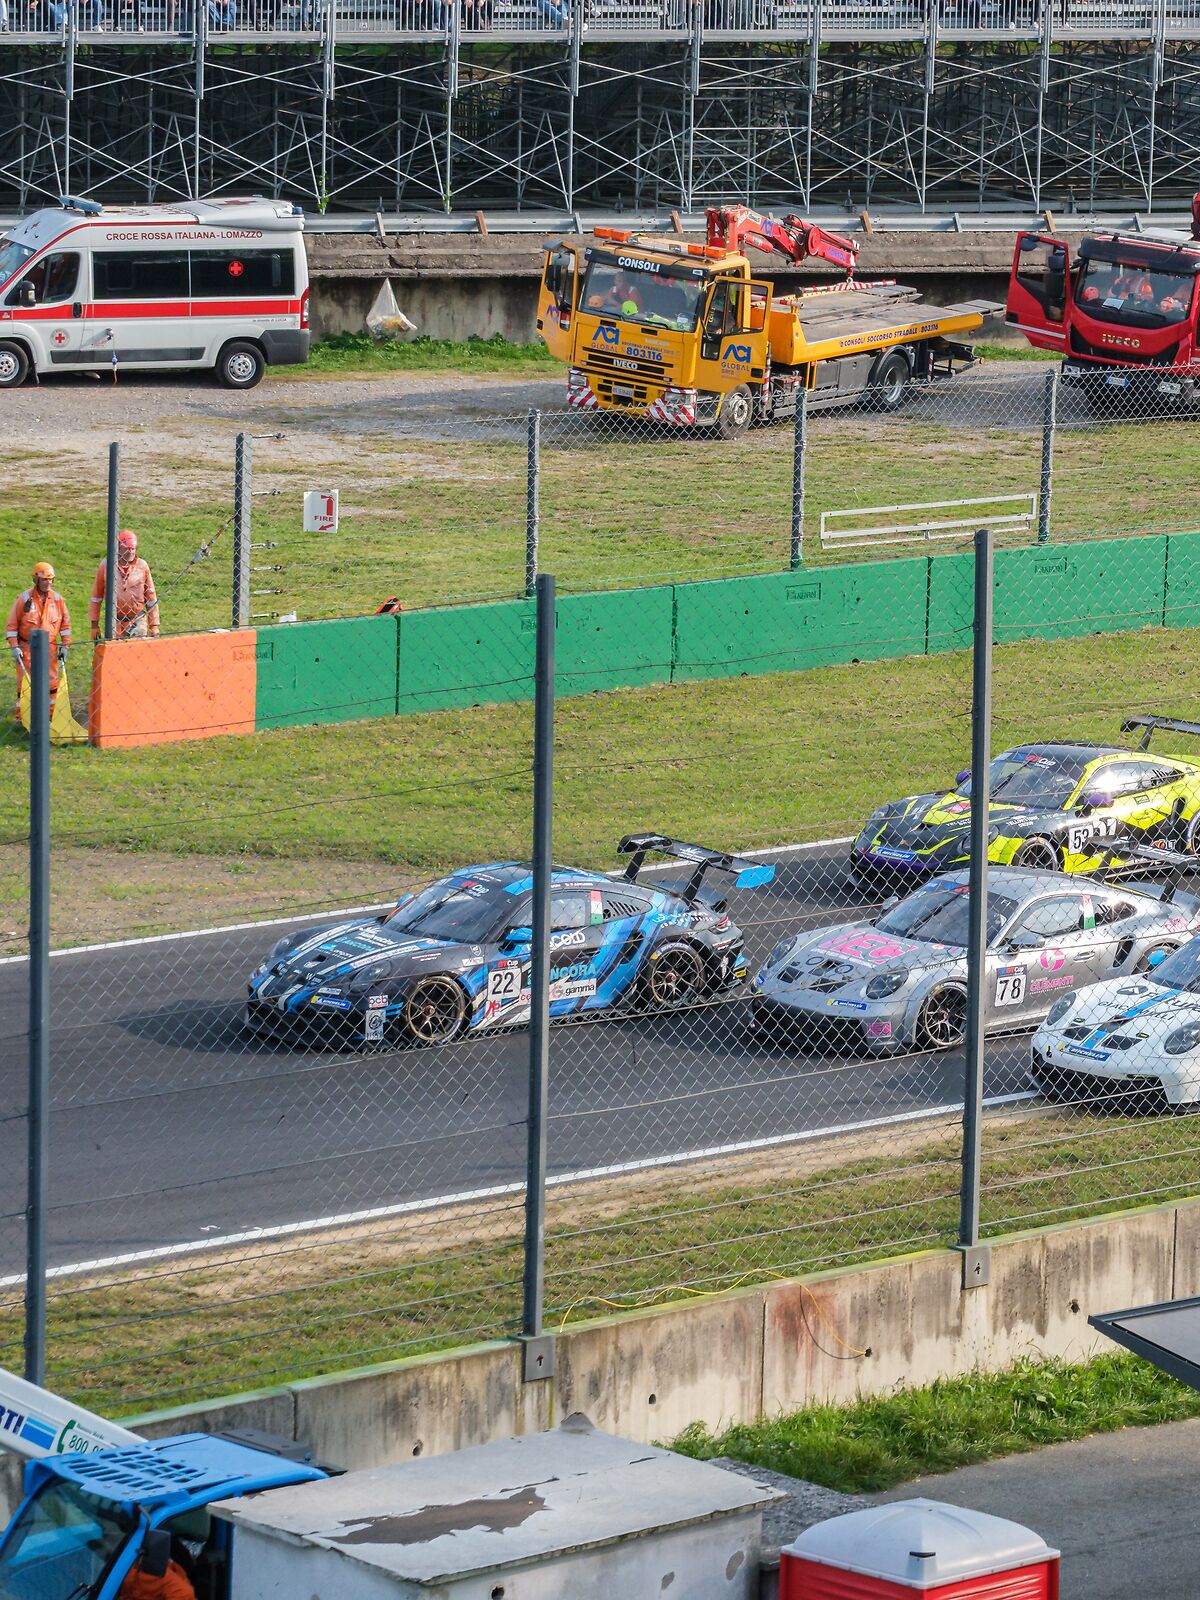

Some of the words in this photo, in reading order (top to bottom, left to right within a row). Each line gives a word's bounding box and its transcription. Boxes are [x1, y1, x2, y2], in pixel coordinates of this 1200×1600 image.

[106, 233, 139, 241] CROCE
[141, 232, 173, 240] ROSSA
[174, 231, 216, 240] ITALIANA
[221, 230, 263, 239] LOMAZZO
[618, 256, 661, 272] CONSOLI
[592, 325, 620, 345] ACI
[867, 332, 893, 343] SOCCORSO
[893, 327, 918, 338] STRADALE
[1102, 333, 1141, 349] IVECO
[626, 346, 663, 361] 803.116
[722, 343, 752, 364] ACI
[613, 359, 638, 370] IVECO
[721, 361, 750, 371] GLOBAL
[314, 515, 334, 523] FIRE
[882, 850, 911, 860] MICHELIN
[549, 963, 597, 980] NCORA
[492, 972, 514, 995] 22
[565, 986, 595, 996] gamma
[999, 978, 1021, 1001] 78
[1029, 974, 1074, 992] CLEMENTI
[1071, 1047, 1107, 1060] MICHELIN
[68, 1434, 89, 1454] 800
